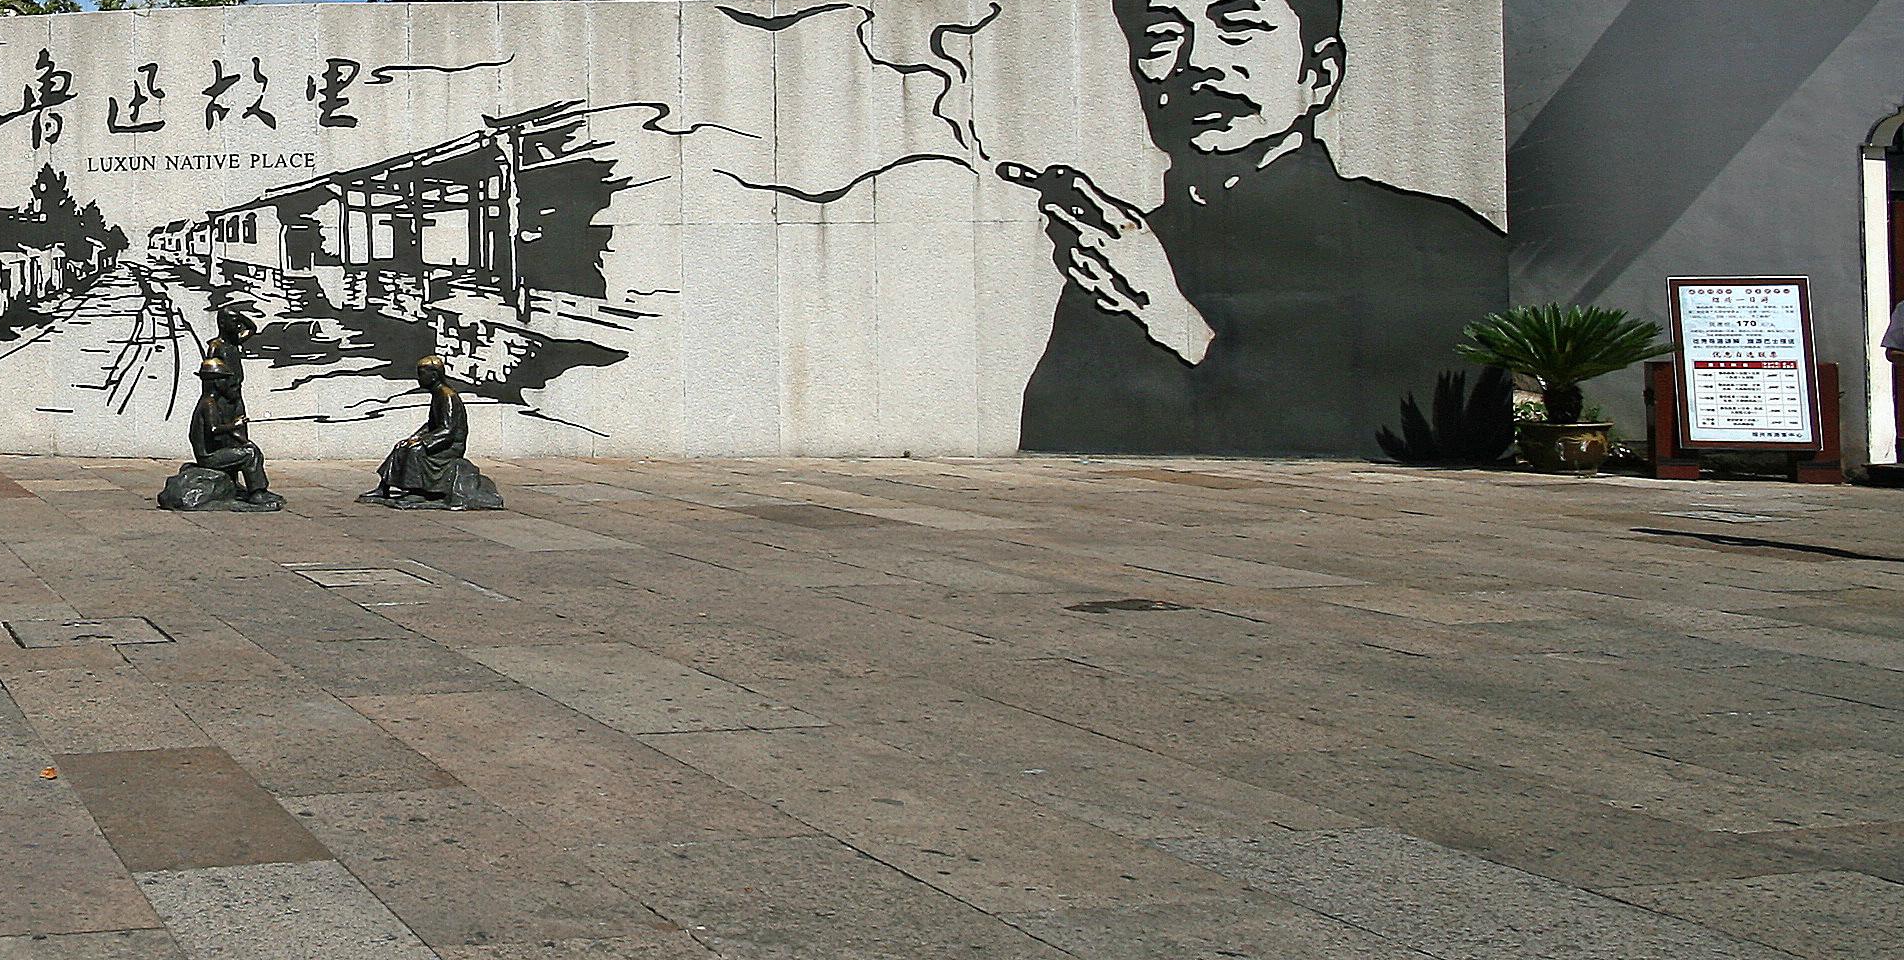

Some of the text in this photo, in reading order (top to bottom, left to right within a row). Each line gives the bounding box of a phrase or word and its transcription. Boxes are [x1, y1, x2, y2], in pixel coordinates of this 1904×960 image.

[87, 152, 315, 173] LUXUN NATIVE PLACE
